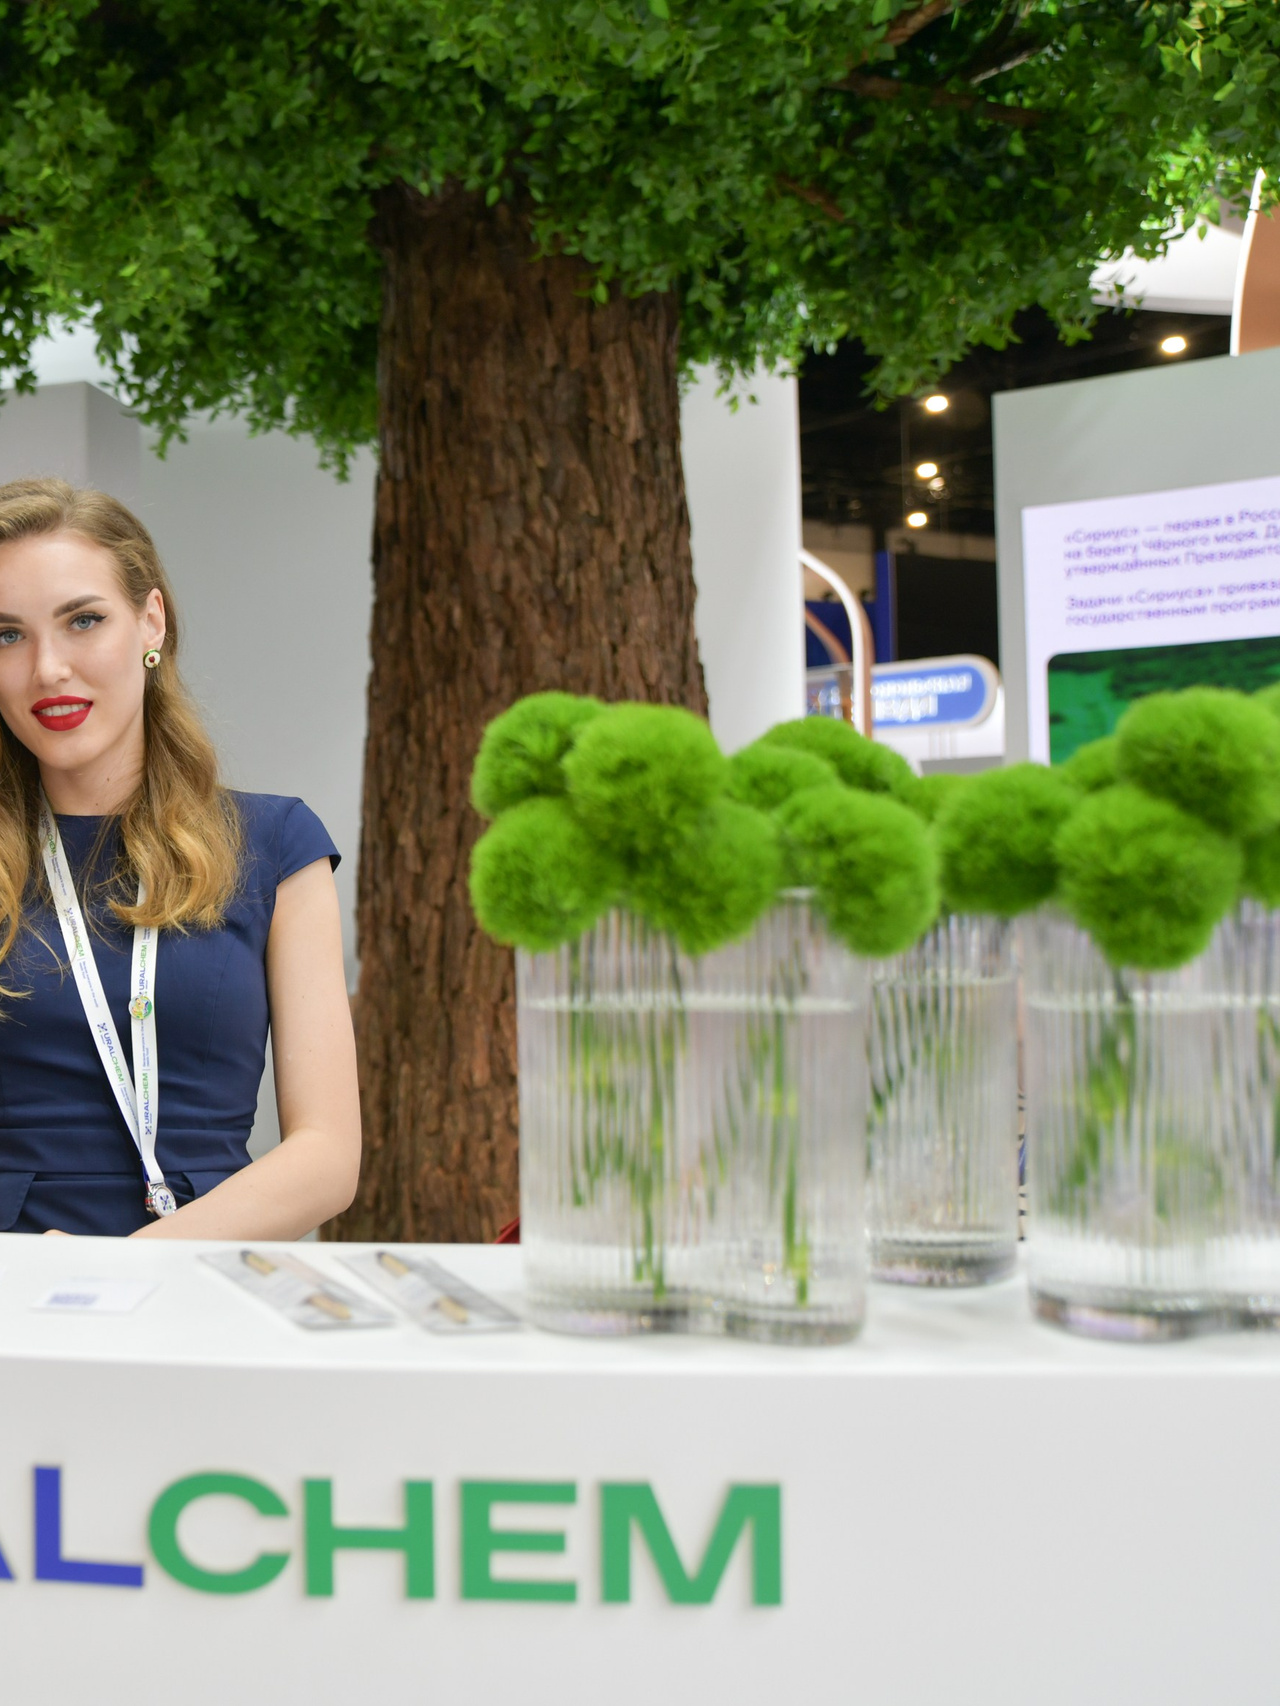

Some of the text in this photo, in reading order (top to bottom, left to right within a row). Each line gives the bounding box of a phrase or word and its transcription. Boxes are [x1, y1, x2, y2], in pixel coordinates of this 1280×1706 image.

[1238, 508, 1280, 523] Росс
[69, 915, 85, 957] URALCHEM
[139, 944, 148, 991] URALCHEM
[103, 1032, 124, 1082] URALCHEM
[142, 1072, 150, 1124] URALCHEM
